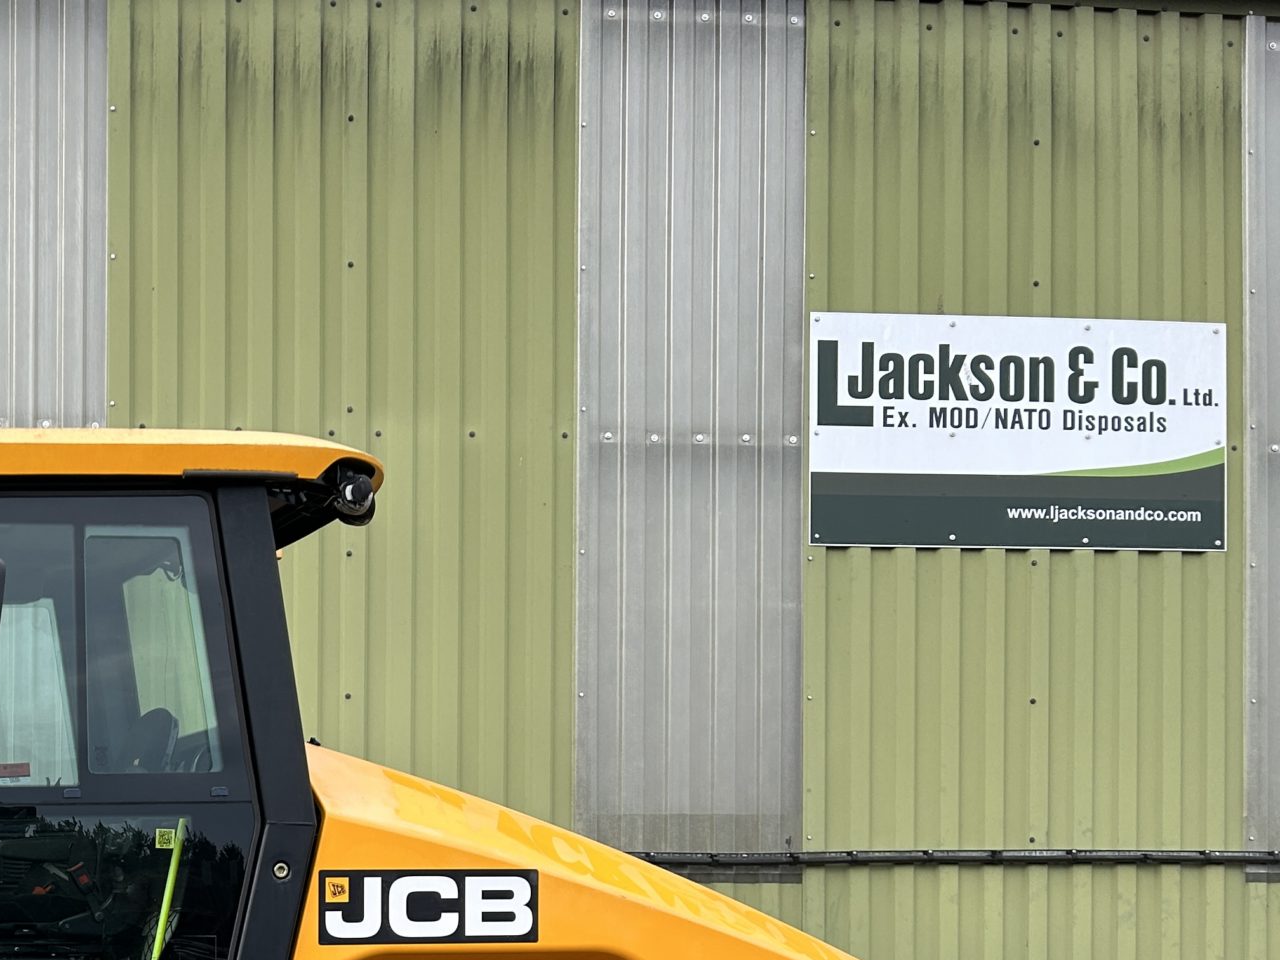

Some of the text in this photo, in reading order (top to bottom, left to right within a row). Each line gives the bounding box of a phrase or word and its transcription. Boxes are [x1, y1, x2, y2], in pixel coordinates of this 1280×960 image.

[1068, 345, 1099, 404] &
[1112, 347, 1176, 406] Co.
[1183, 388, 1219, 407] Ltd.
[882, 407, 1167, 435] Ex. MOD/NATO Disposals
[1007, 506, 1202, 523] www.ljacksonandco.com
[325, 875, 533, 938] JCB
